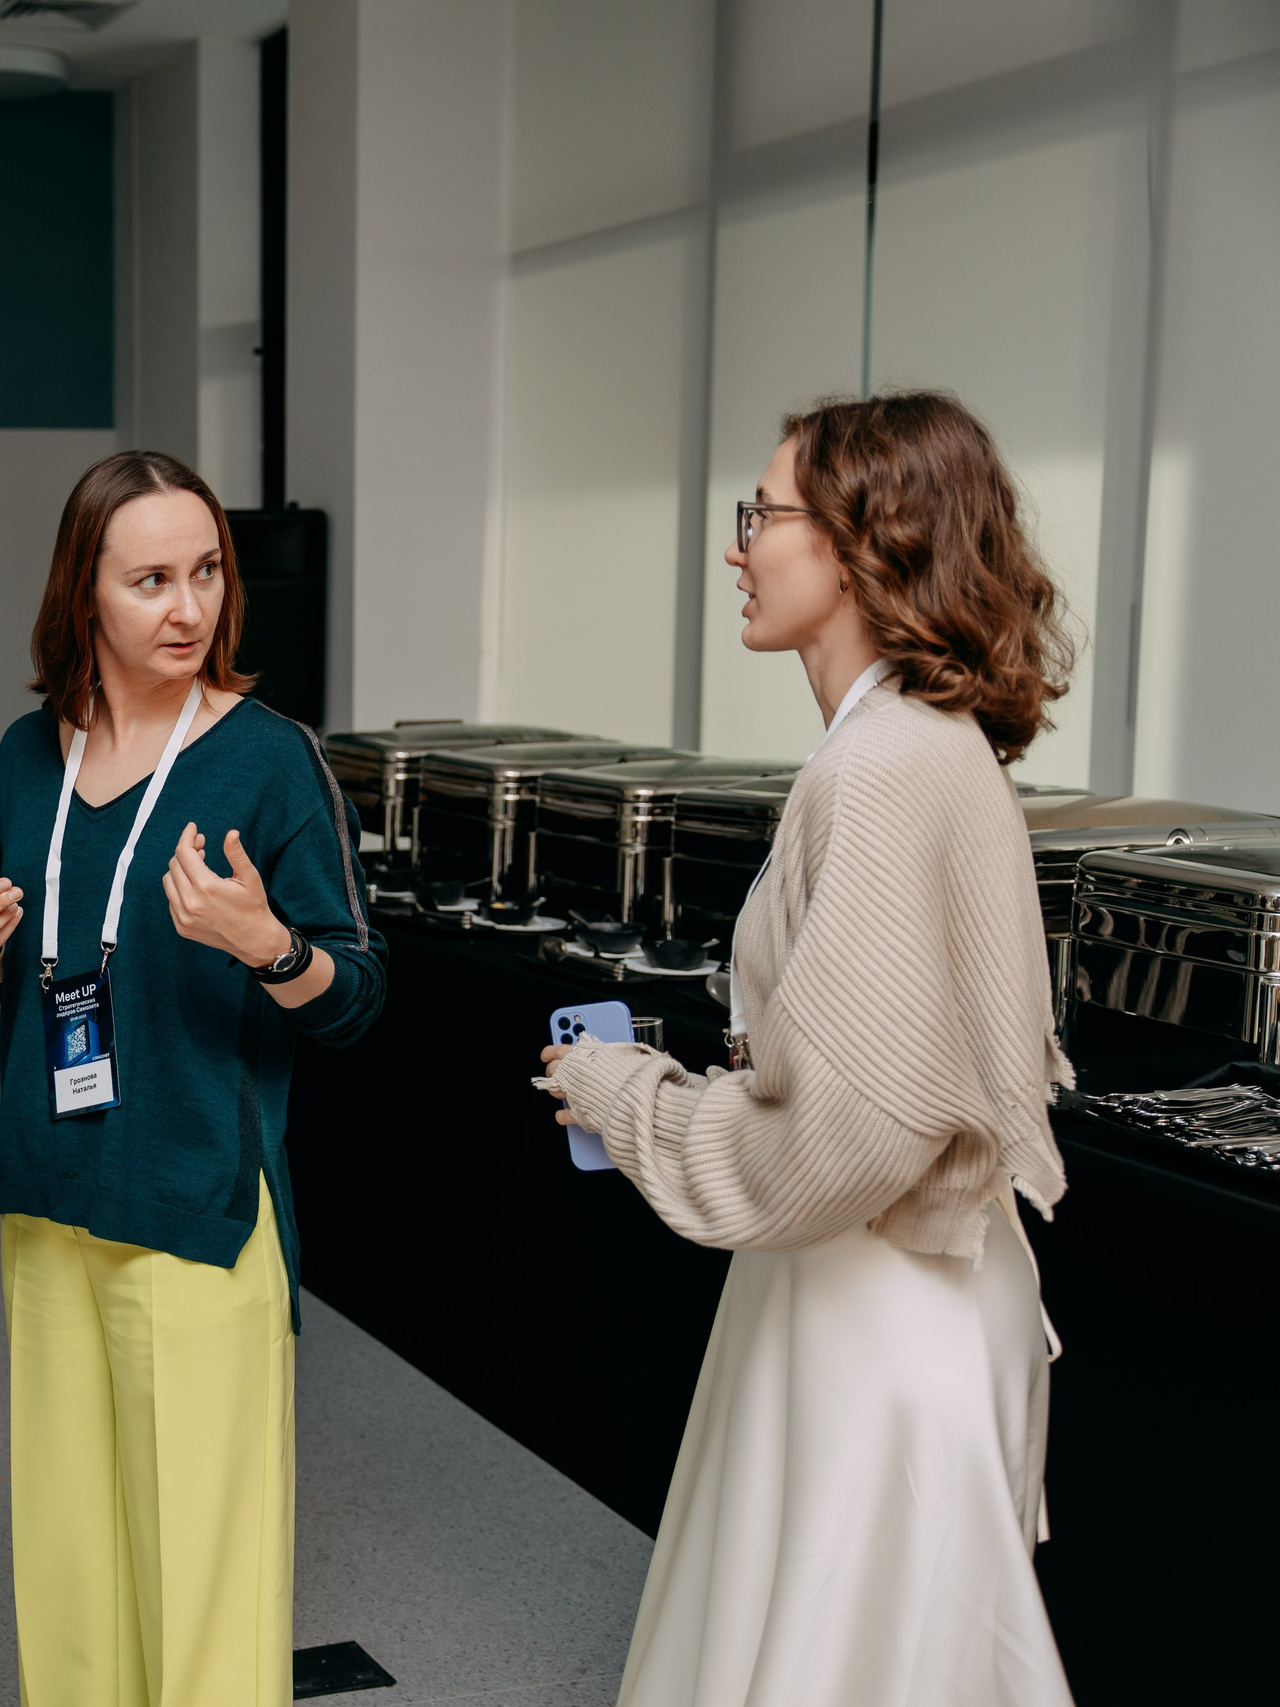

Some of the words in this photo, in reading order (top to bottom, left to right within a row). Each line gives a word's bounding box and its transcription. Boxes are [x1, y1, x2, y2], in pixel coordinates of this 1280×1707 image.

[55, 989, 80, 1004] Meet
[81, 983, 96, 997] UP
[56, 1009, 76, 1018] лидеров
[70, 1073, 97, 1086] Грознова
[73, 1083, 97, 1095] Наталья
